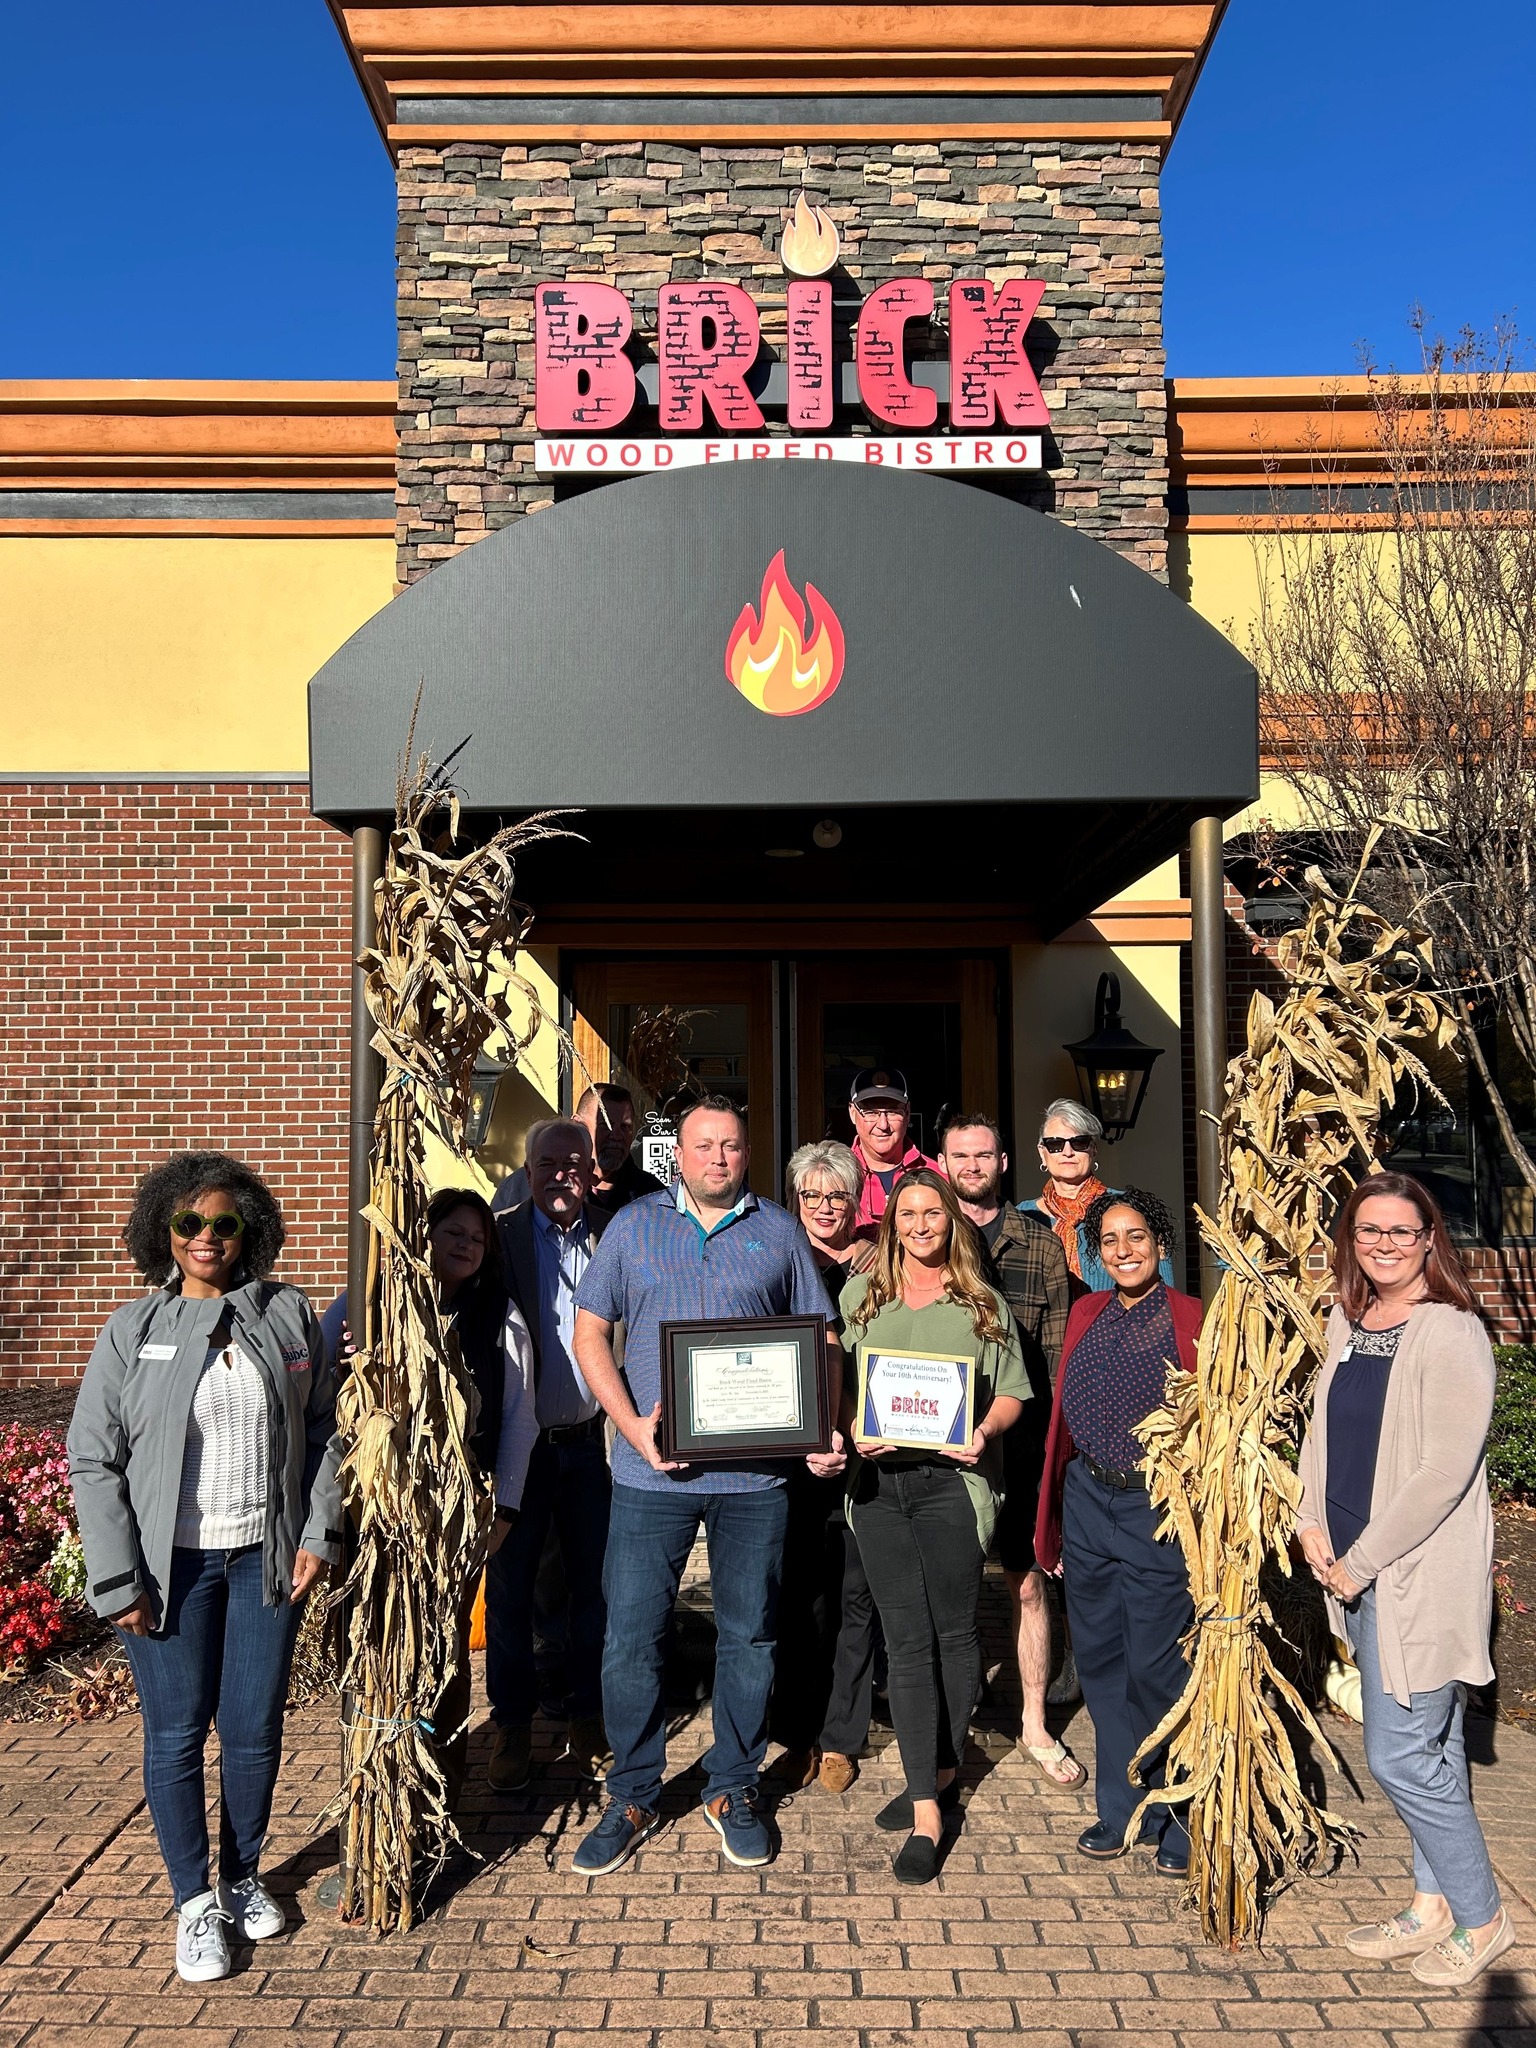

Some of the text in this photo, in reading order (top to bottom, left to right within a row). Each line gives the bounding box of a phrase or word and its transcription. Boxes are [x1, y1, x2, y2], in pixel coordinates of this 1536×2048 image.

[547, 441, 1027, 467] WOOD FIRED BISTRO
[645, 1111, 671, 1124] Scan
[650, 1124, 671, 1136] Our
[887, 1361, 947, 1374] Congratulations On
[882, 1370, 953, 1384] Your 10th Anniversary!
[891, 1395, 939, 1416] BRICK
